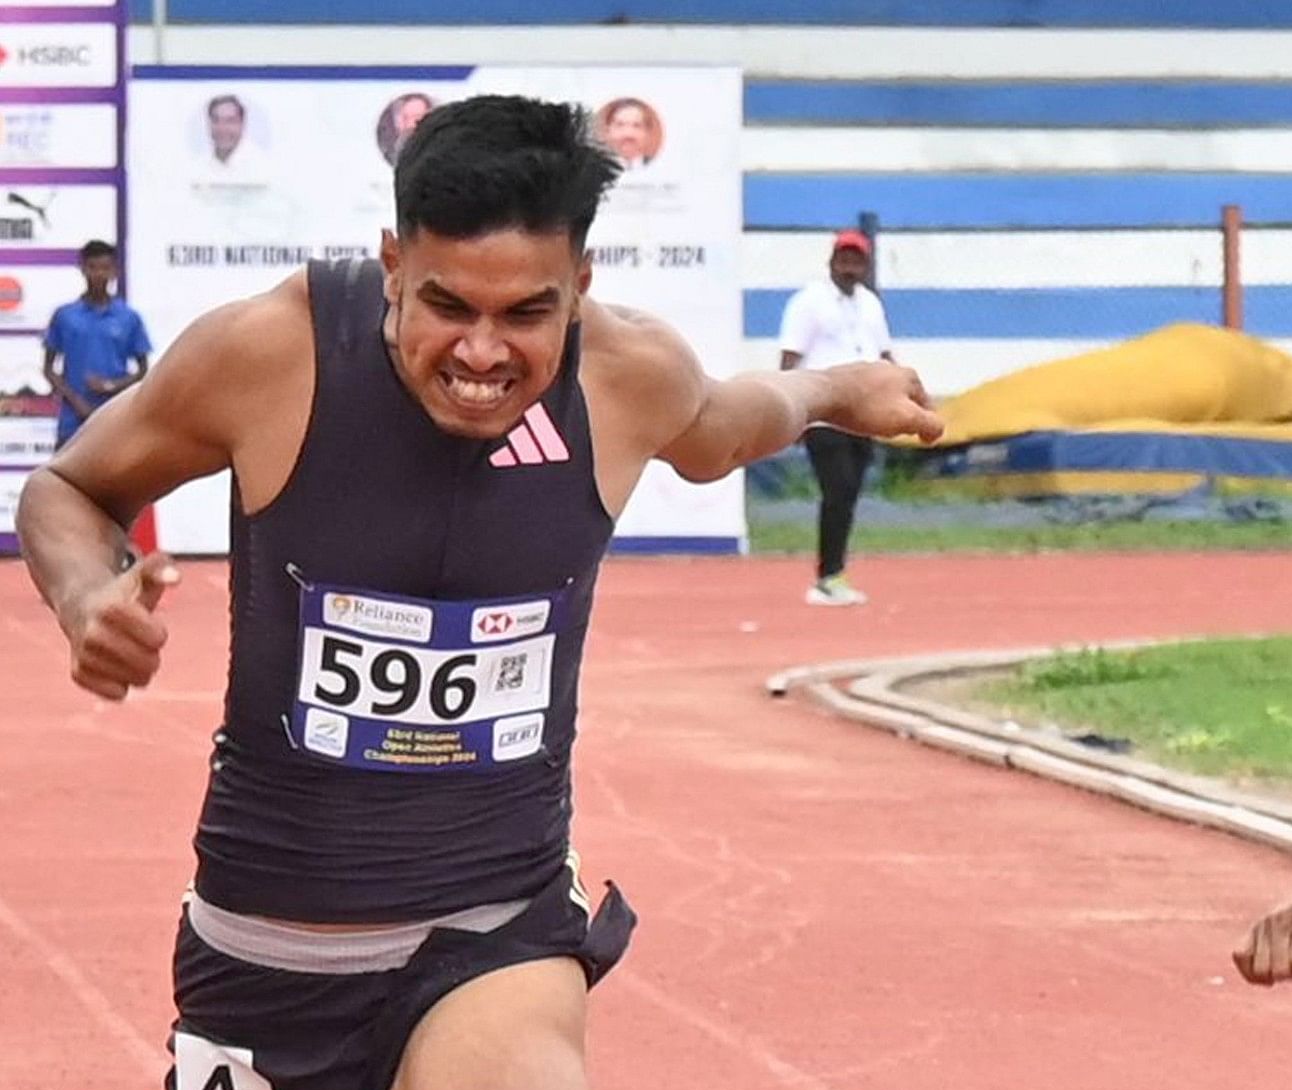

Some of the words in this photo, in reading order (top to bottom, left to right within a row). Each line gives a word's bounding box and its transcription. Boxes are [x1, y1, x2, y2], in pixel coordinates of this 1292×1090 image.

[17, 46, 89, 65] HSBC
[660, 246, 706, 267] 2024
[354, 600, 423, 624] Reliance
[315, 636, 478, 720] 596
